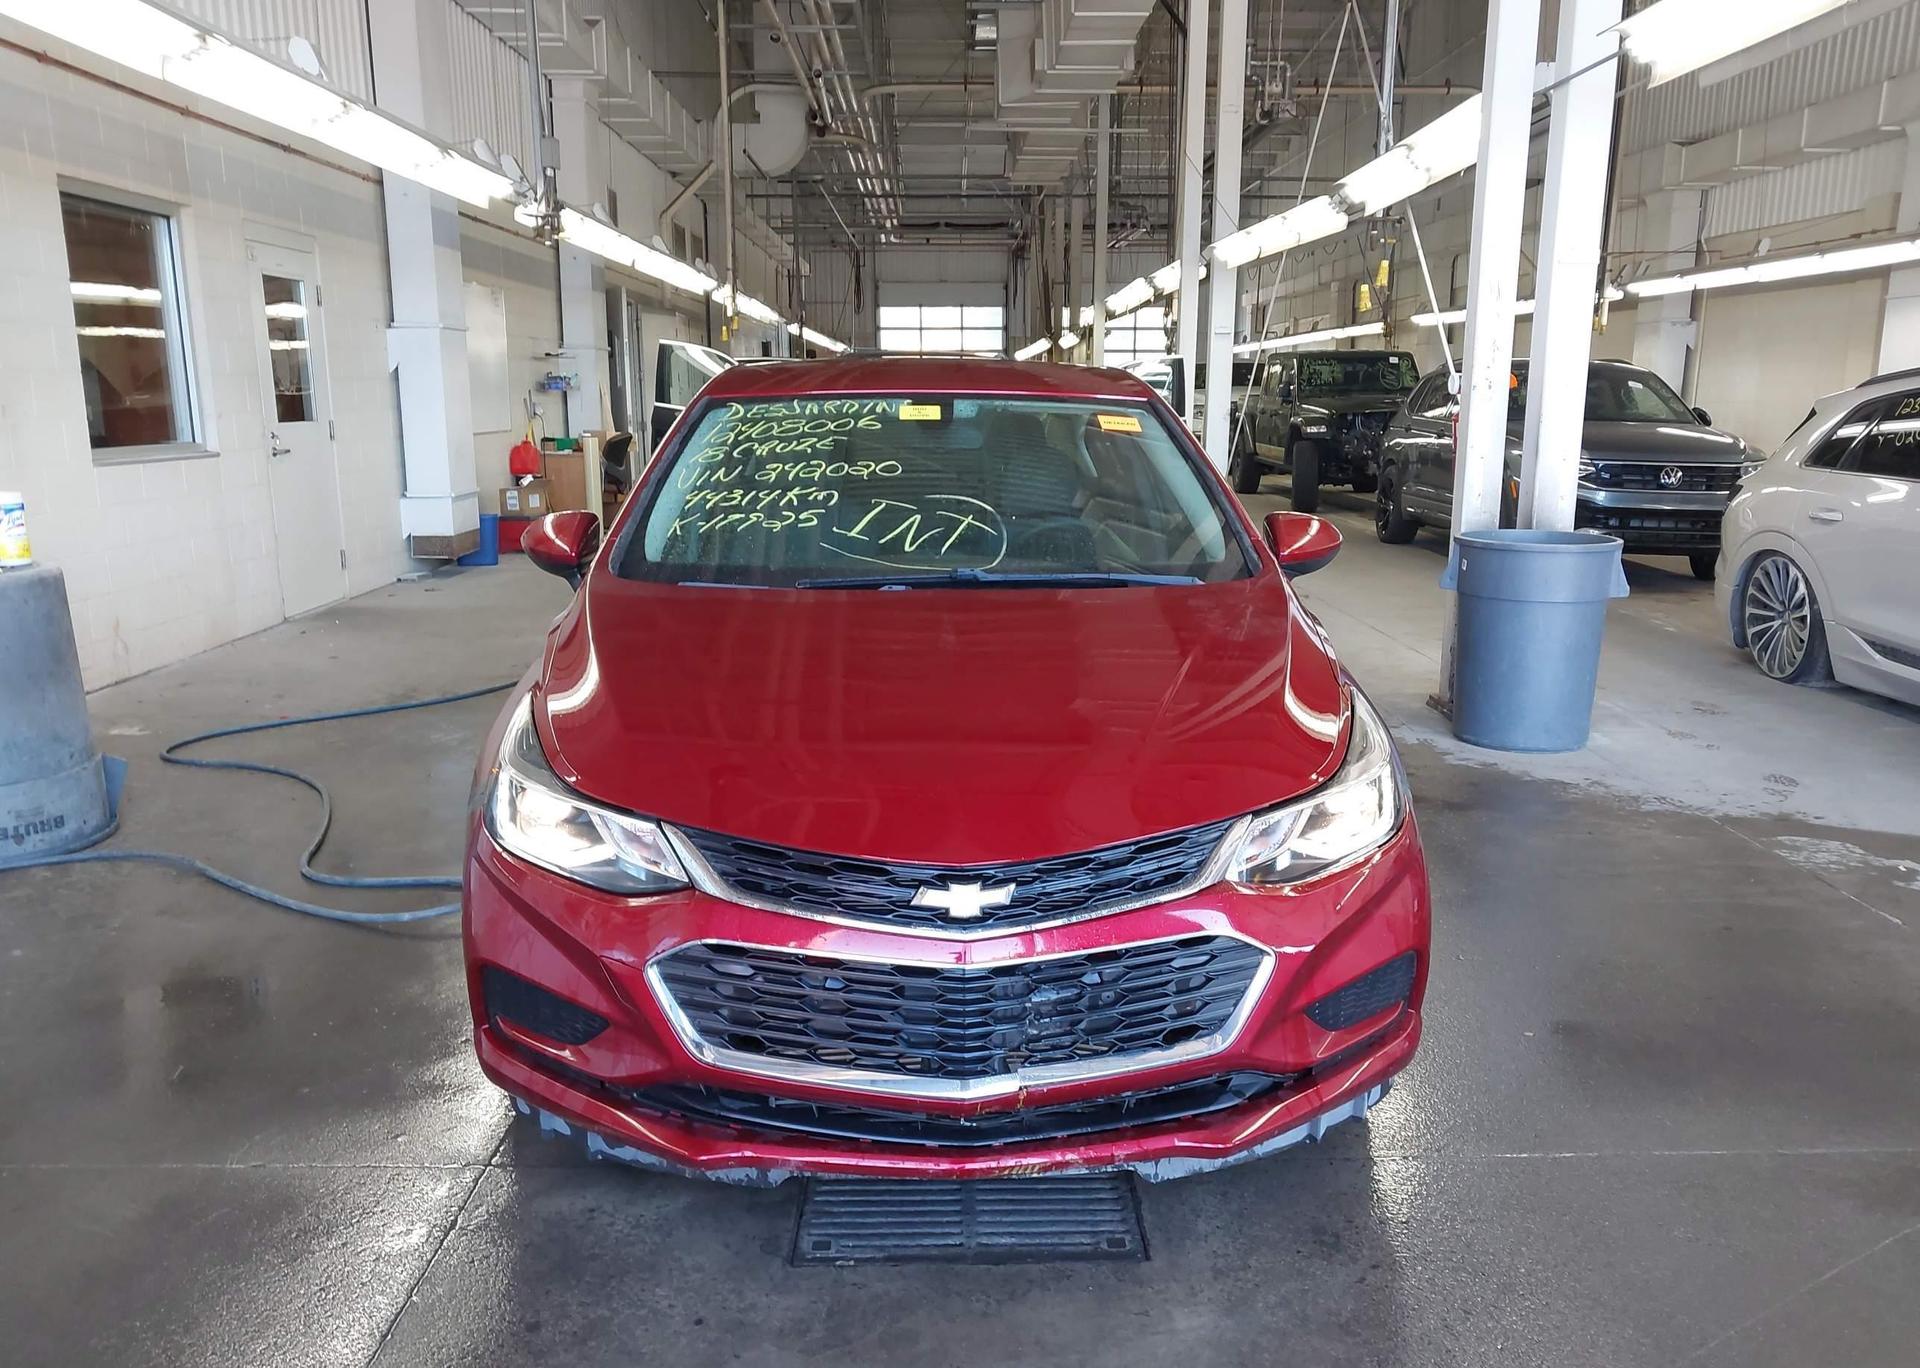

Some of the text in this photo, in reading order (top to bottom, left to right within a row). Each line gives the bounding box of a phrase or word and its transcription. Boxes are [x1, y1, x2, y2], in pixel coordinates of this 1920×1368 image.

[703, 416, 882, 444] 12408006
[733, 436, 848, 457] CRUZE
[678, 461, 902, 489] VIN 242020
[832, 499, 998, 556] INT
